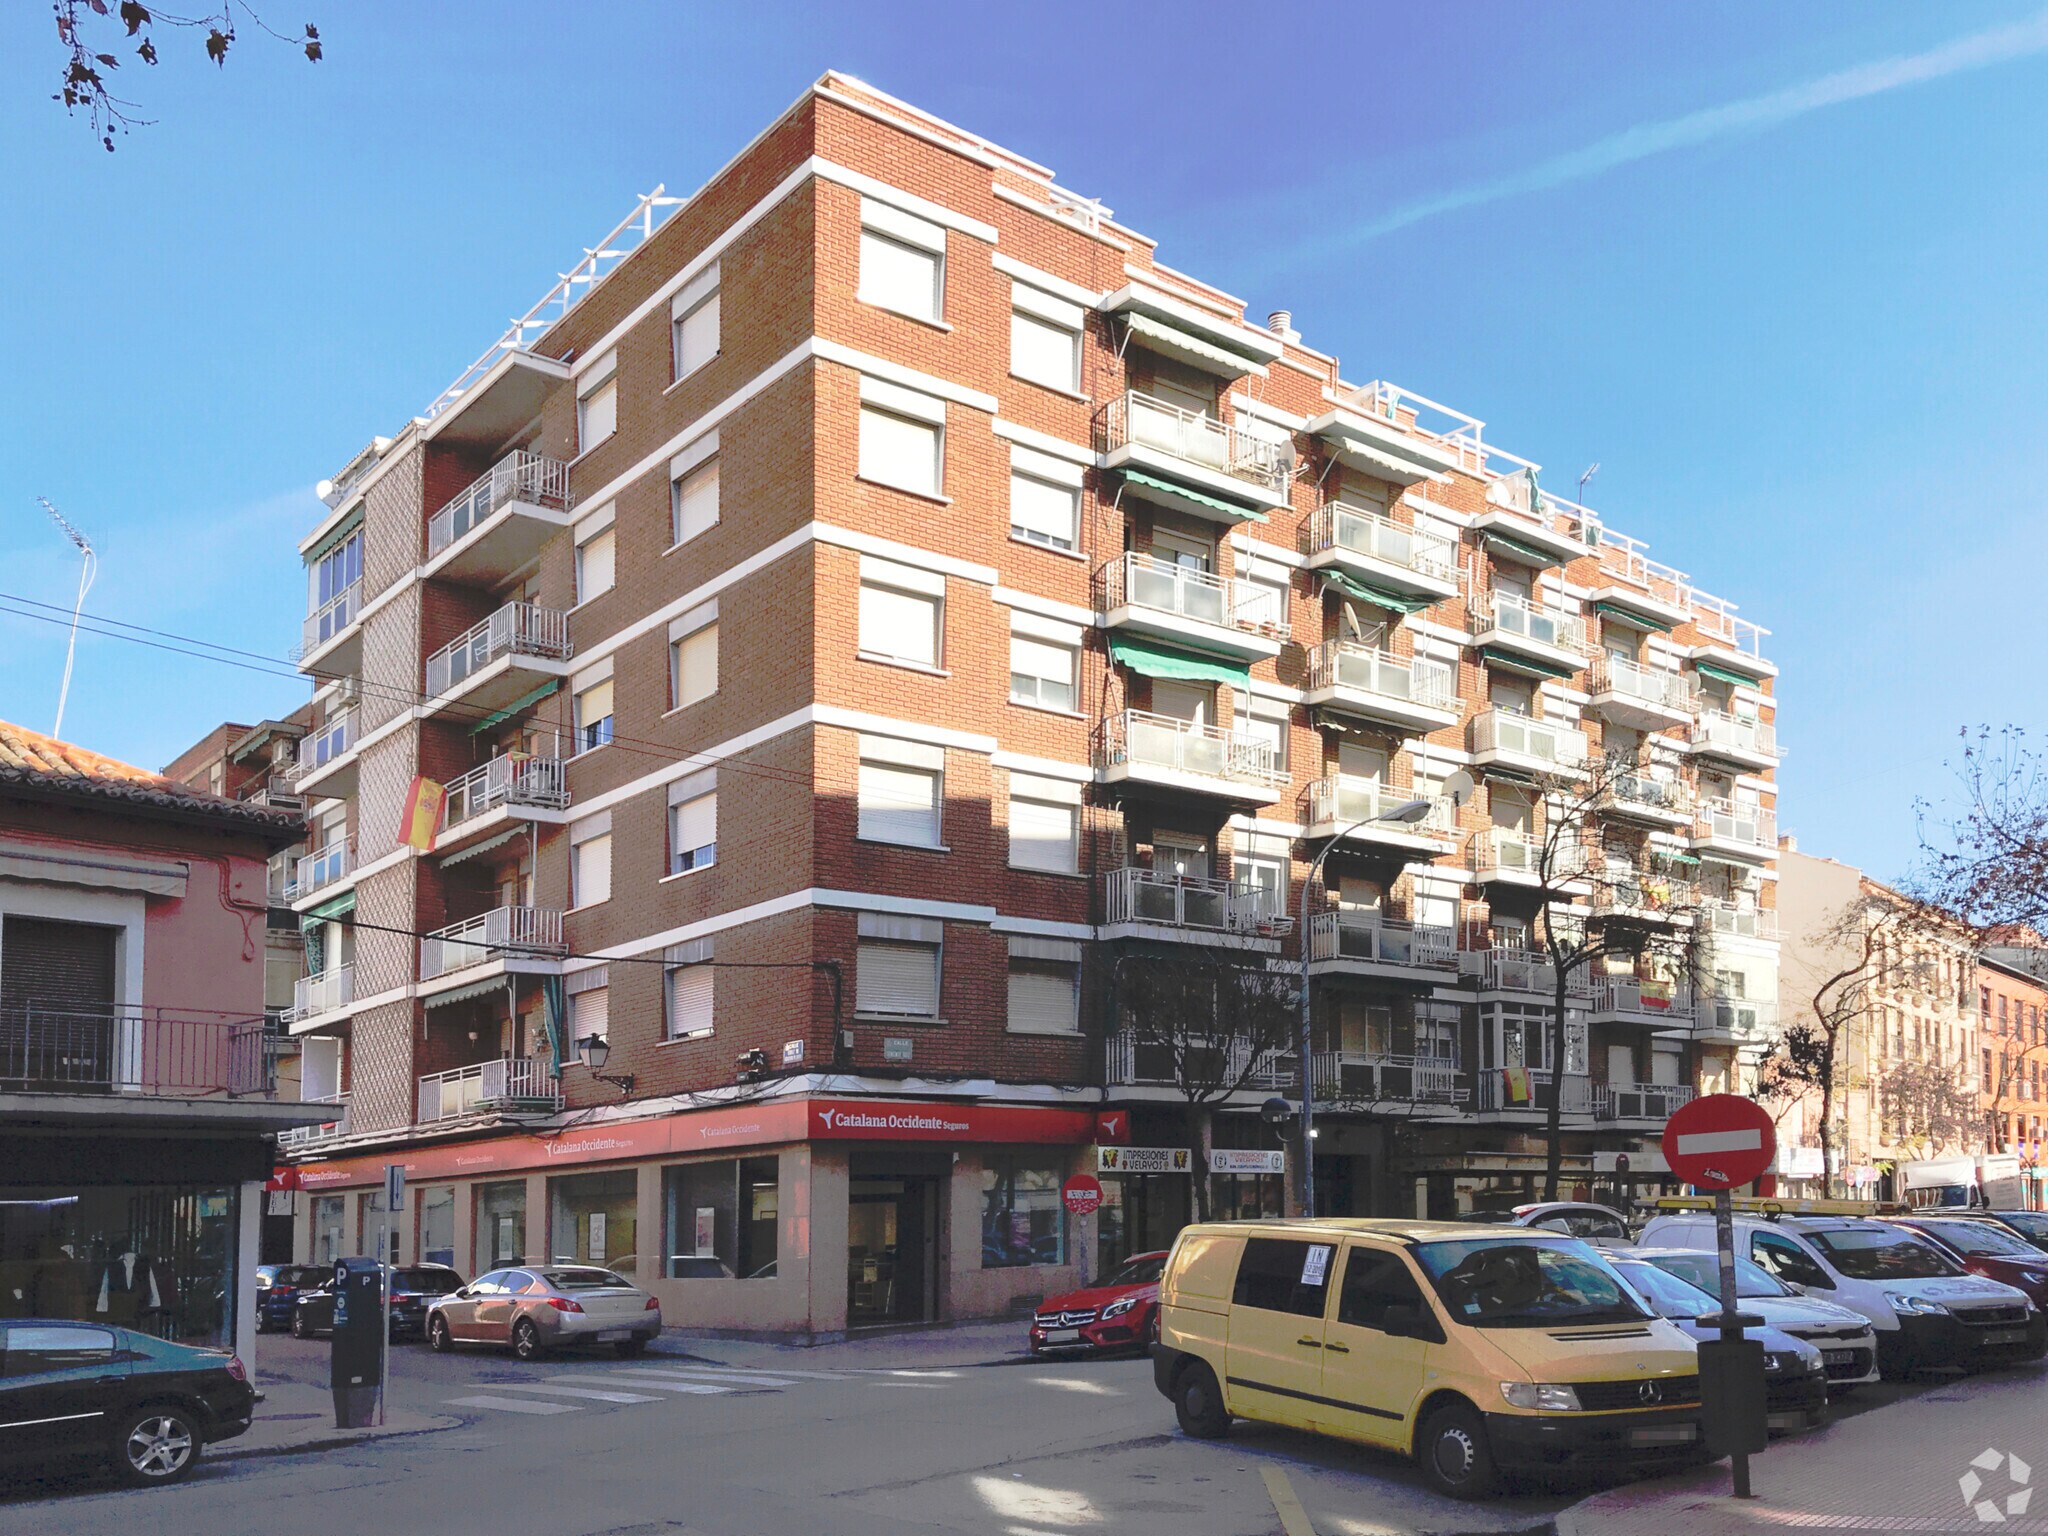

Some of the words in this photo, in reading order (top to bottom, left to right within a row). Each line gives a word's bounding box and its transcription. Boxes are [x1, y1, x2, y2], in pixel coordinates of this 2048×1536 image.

[835, 1113, 887, 1128] Catalana
[888, 1115, 942, 1130] Occidente
[943, 1122, 969, 1131] Seguros
[707, 1127, 732, 1137] Catalana
[732, 1124, 760, 1134] Occidente
[553, 1142, 581, 1154] Catalana
[581, 1138, 615, 1151] Occidente
[1123, 1150, 1169, 1160] IMPRESIONES
[1129, 1160, 1162, 1170] VELAYOS
[336, 1267, 347, 1286] P
[362, 1276, 371, 1286] P
